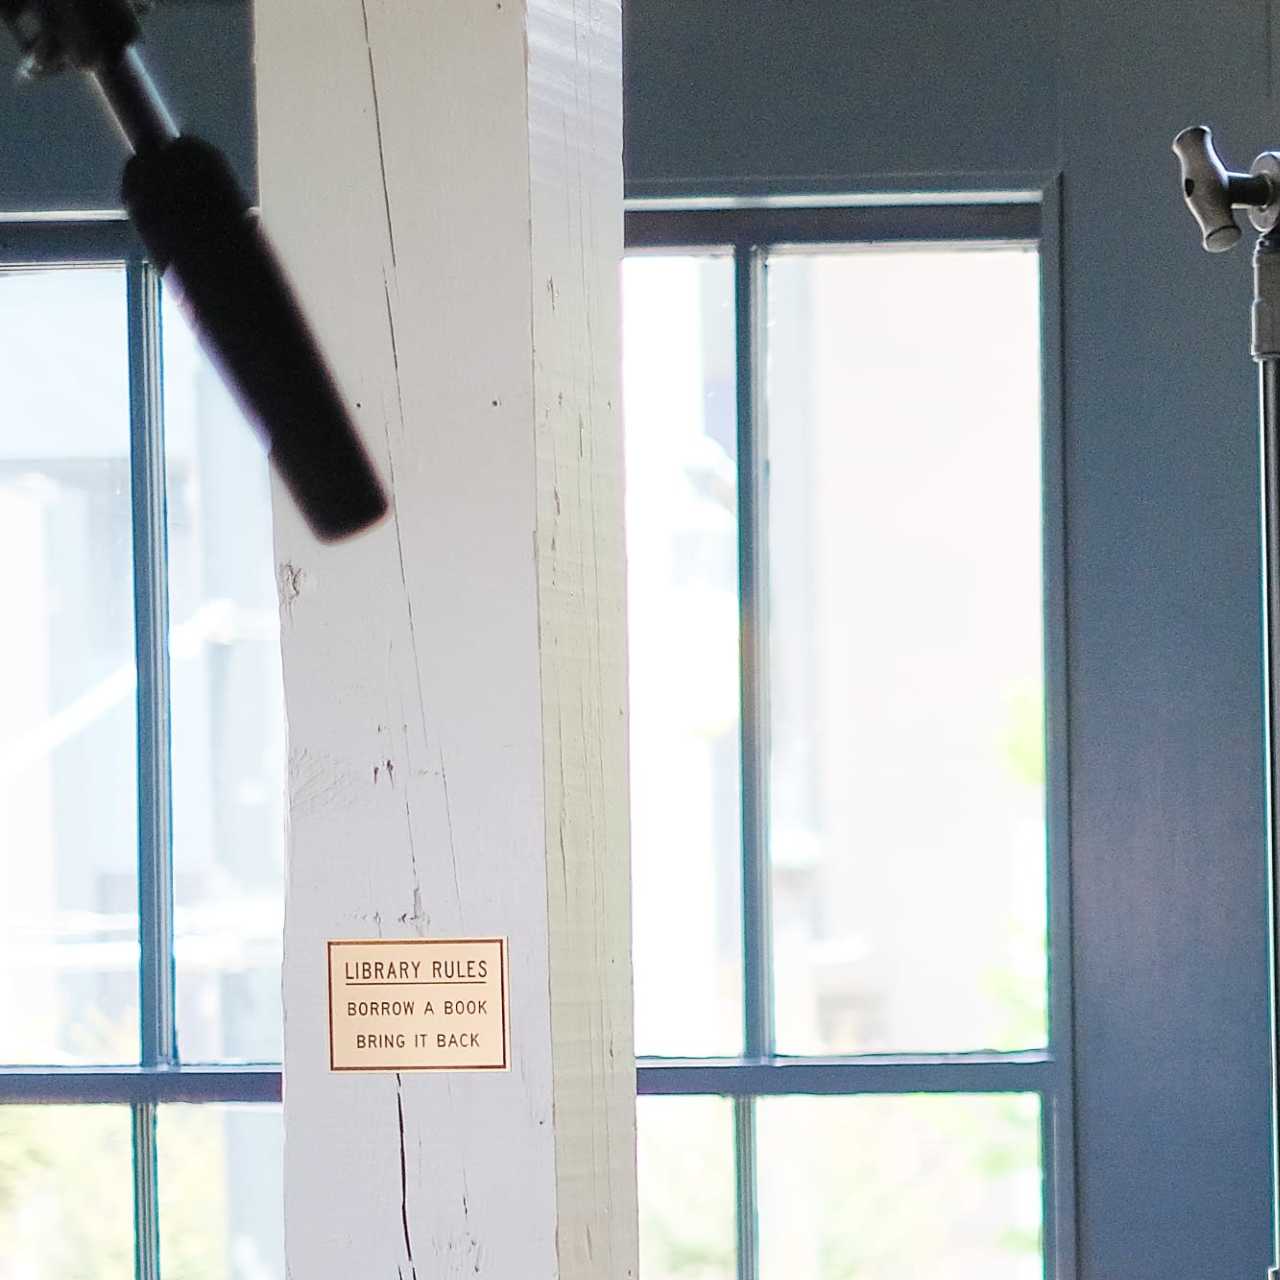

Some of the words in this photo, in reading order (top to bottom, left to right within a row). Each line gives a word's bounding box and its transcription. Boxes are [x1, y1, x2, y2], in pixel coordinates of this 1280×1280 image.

[345, 961, 421, 980] LIBRARY
[432, 960, 488, 978] RULES
[347, 1001, 415, 1016] BORROW
[424, 1002, 434, 1015] A
[444, 1000, 488, 1015] BOOK
[356, 1034, 405, 1049] BRING
[415, 1034, 428, 1047] IT
[437, 1033, 480, 1048] BACK
